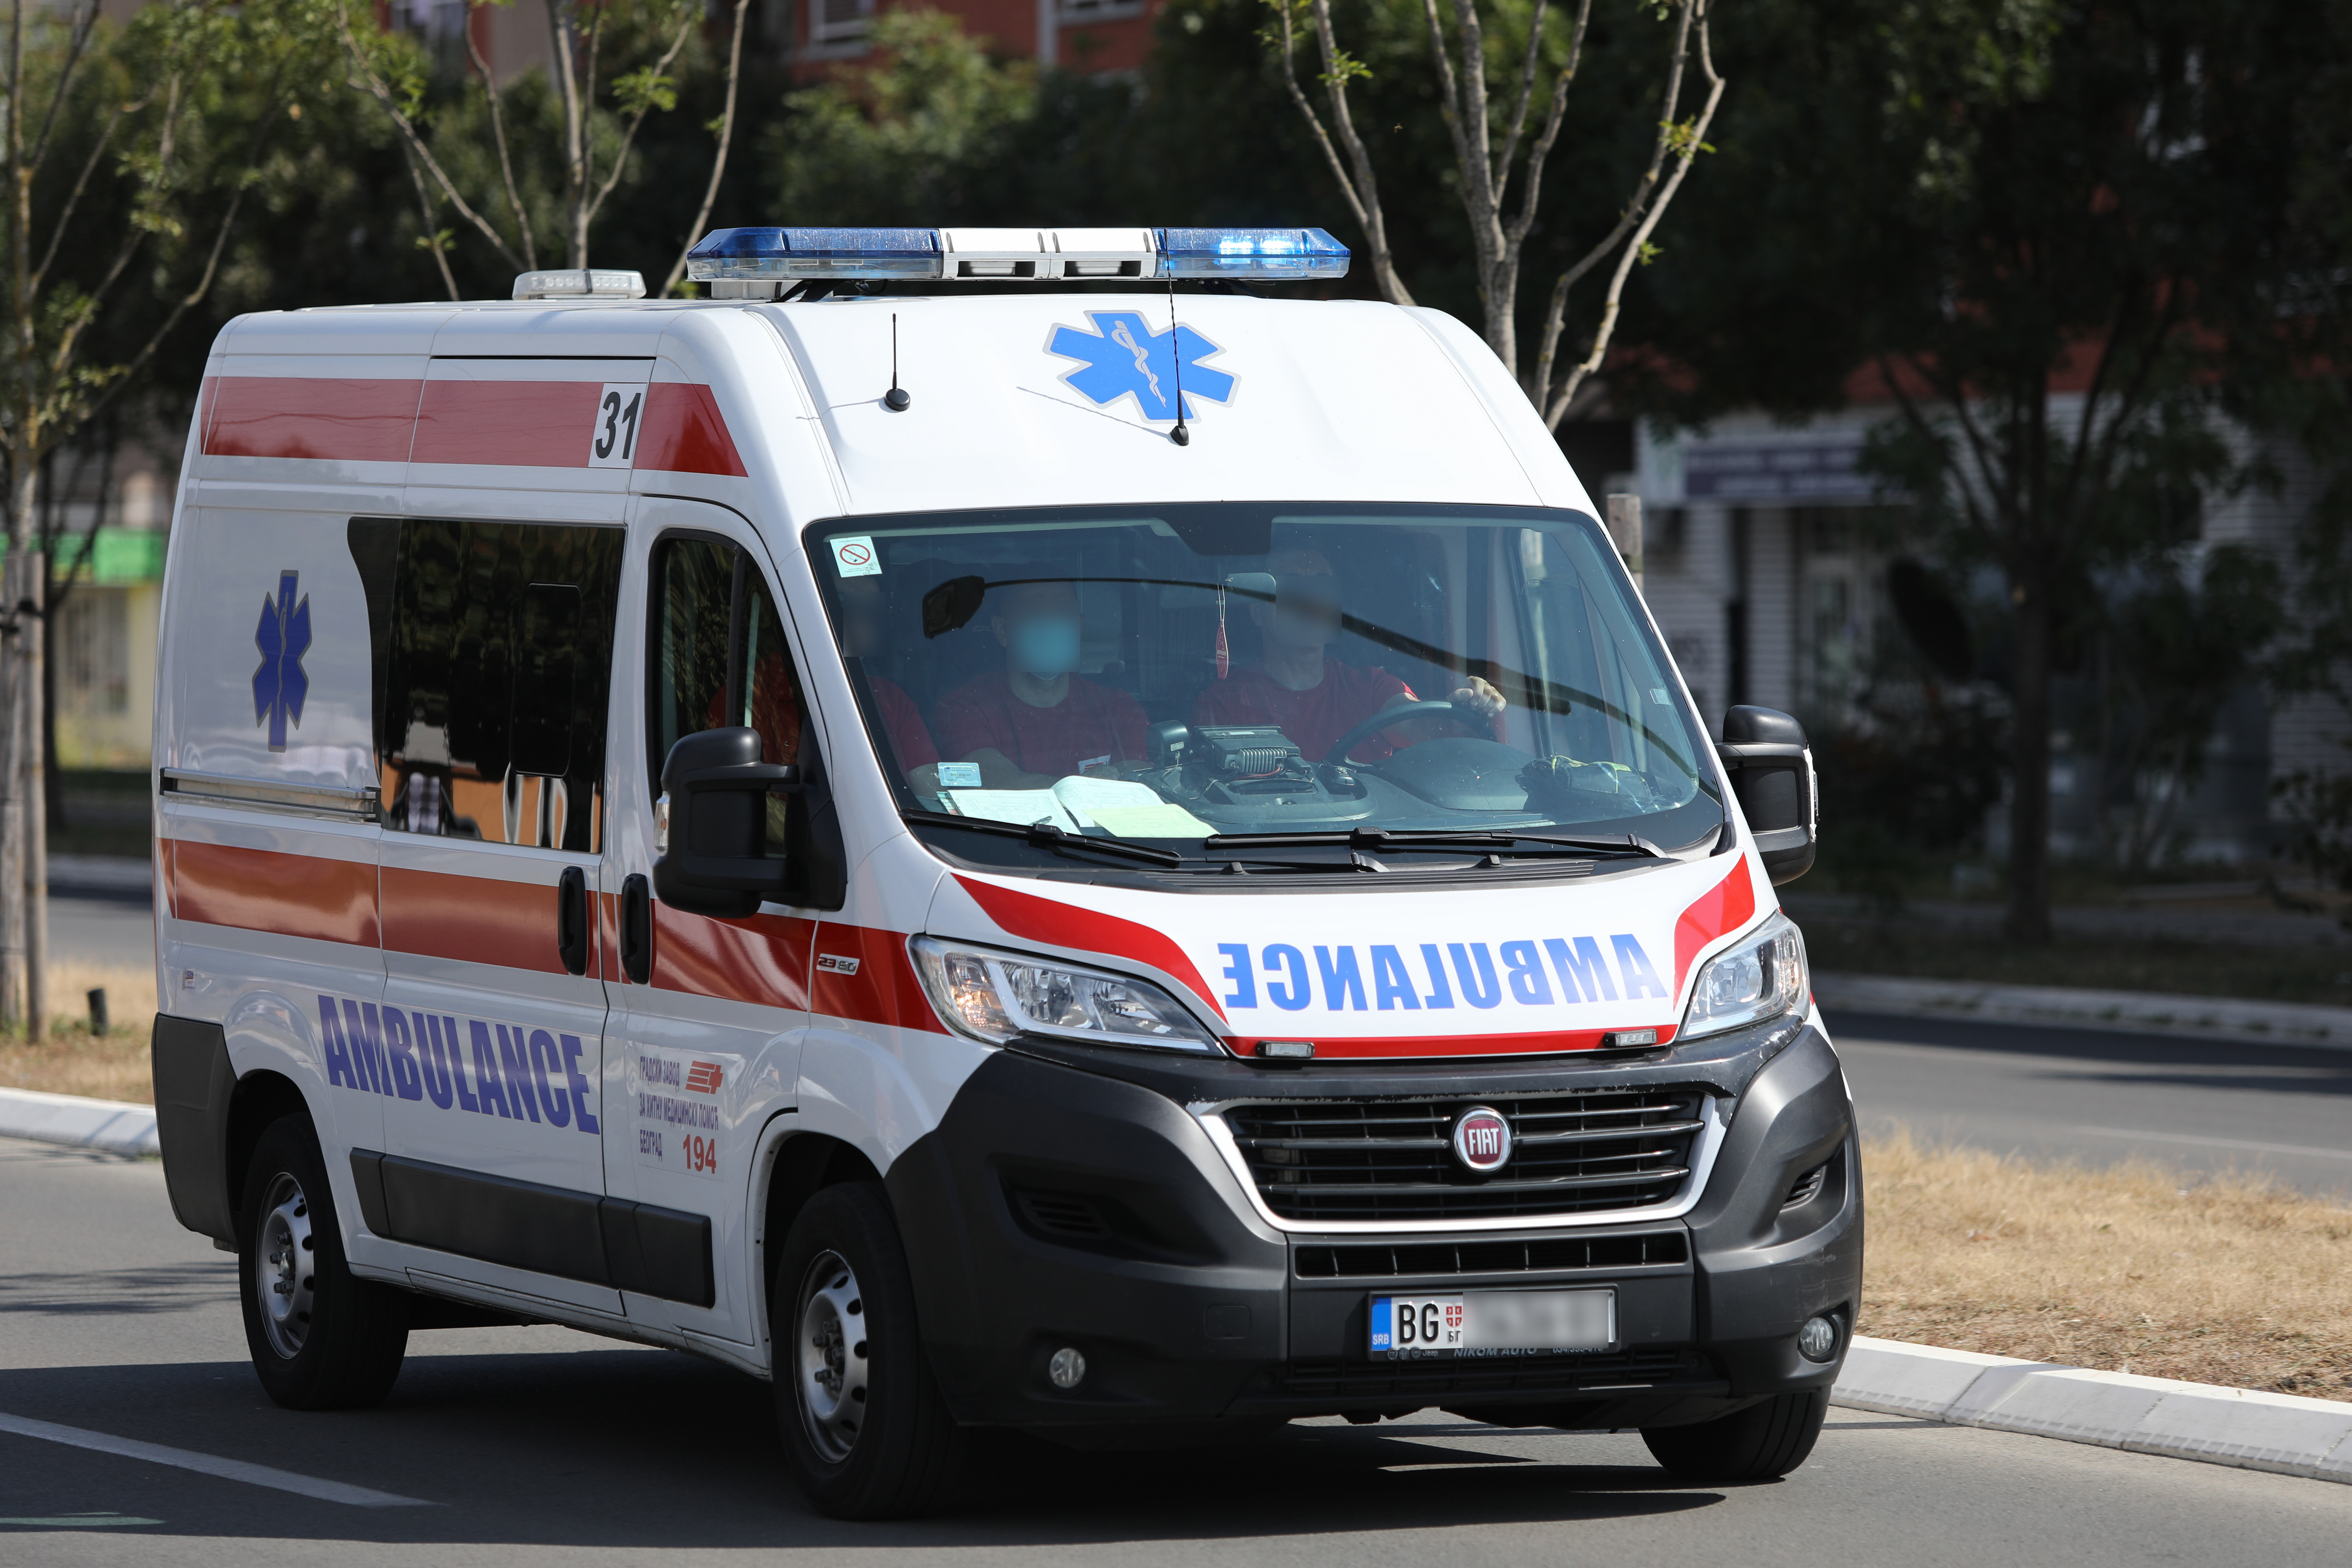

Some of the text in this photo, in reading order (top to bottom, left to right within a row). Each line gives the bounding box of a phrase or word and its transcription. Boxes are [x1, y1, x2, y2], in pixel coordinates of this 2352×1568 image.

[596, 391, 641, 459] 31
[318, 994, 600, 1135] AMBULANCE
[639, 1056, 680, 1092] ГРАДСКИ ЗАВОД
[639, 1092, 718, 1131] ЗА ХИТНУ МЕДИЦИНСКУ ПОМОЋ
[639, 1129, 662, 1162] БЕОГРАД
[683, 1134, 717, 1174] 194
[1468, 1128, 1499, 1155] FIAT
[1372, 1334, 1390, 1345] SRB
[1398, 1303, 1440, 1344] BG
[1453, 1348, 1498, 1357] NIKOM
